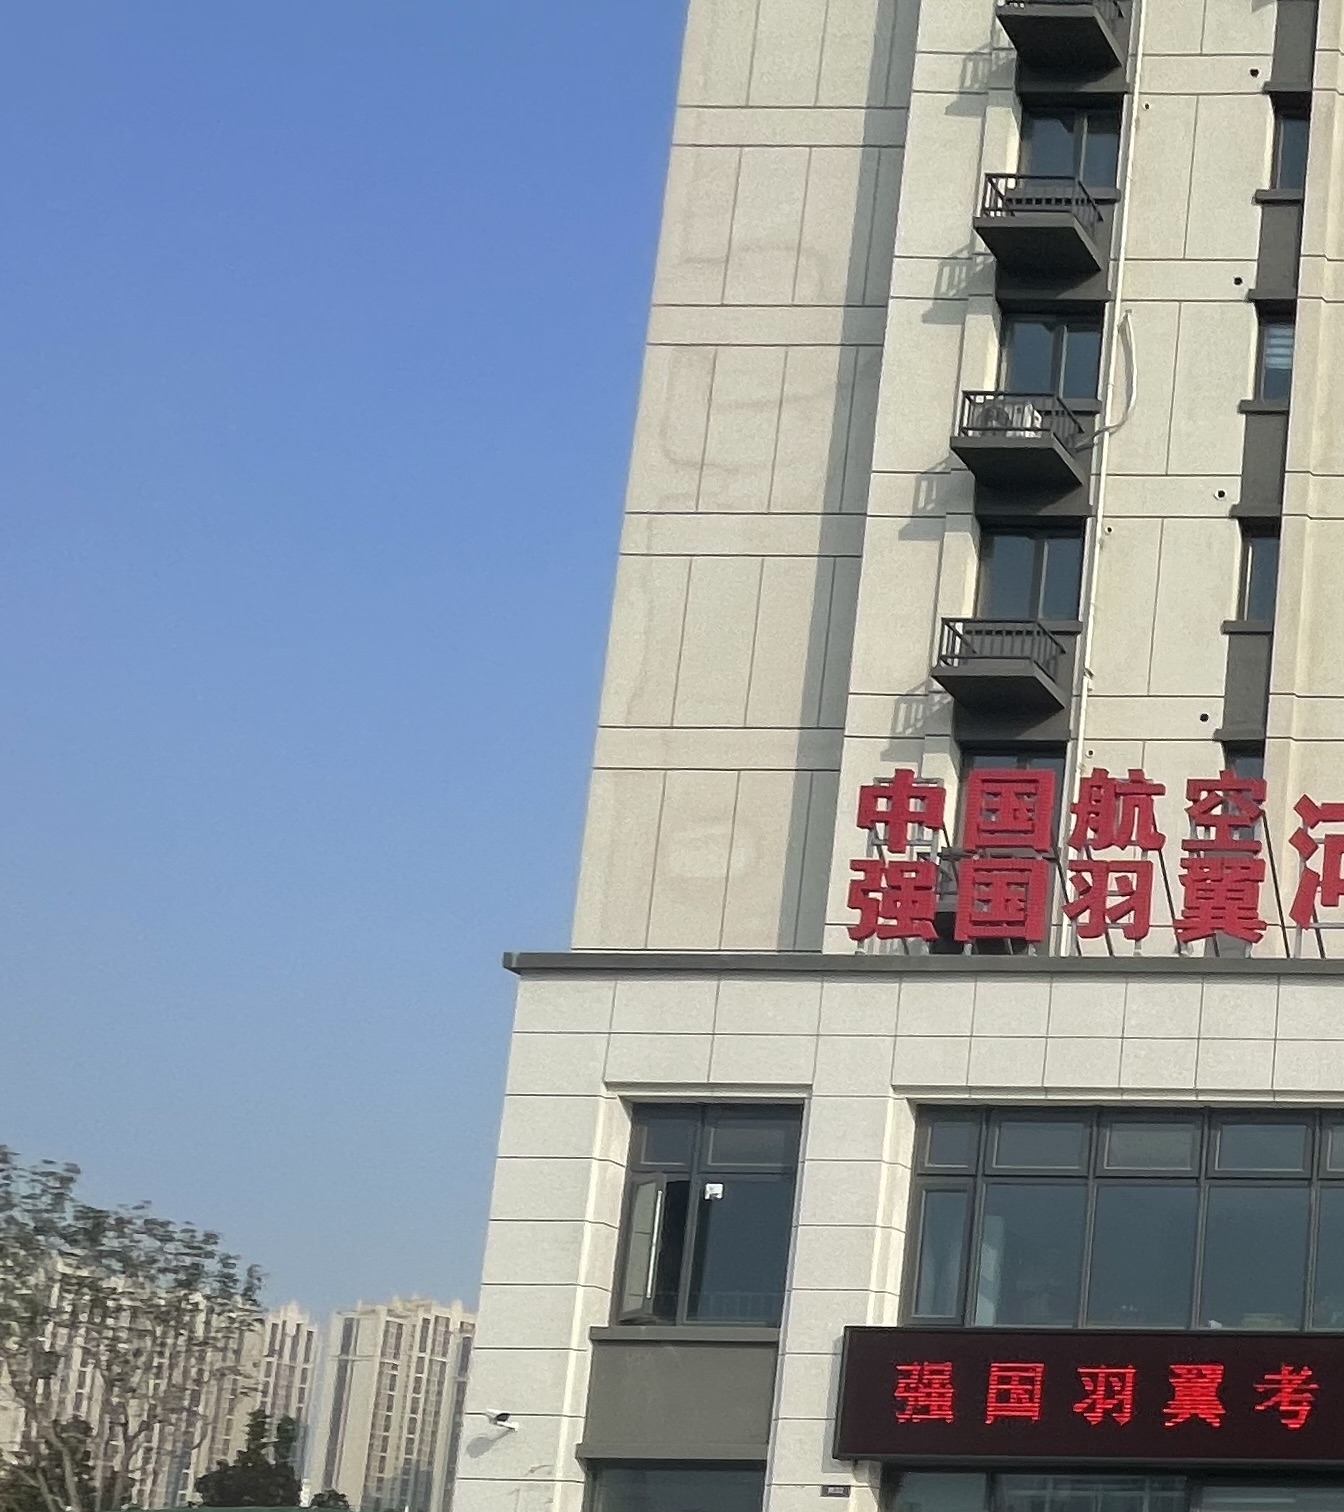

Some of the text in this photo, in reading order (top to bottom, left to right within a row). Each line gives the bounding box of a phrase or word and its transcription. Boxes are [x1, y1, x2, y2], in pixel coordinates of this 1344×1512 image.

[857, 768, 1267, 853] 中国航空
[848, 858, 1267, 943] 强国羽翼
